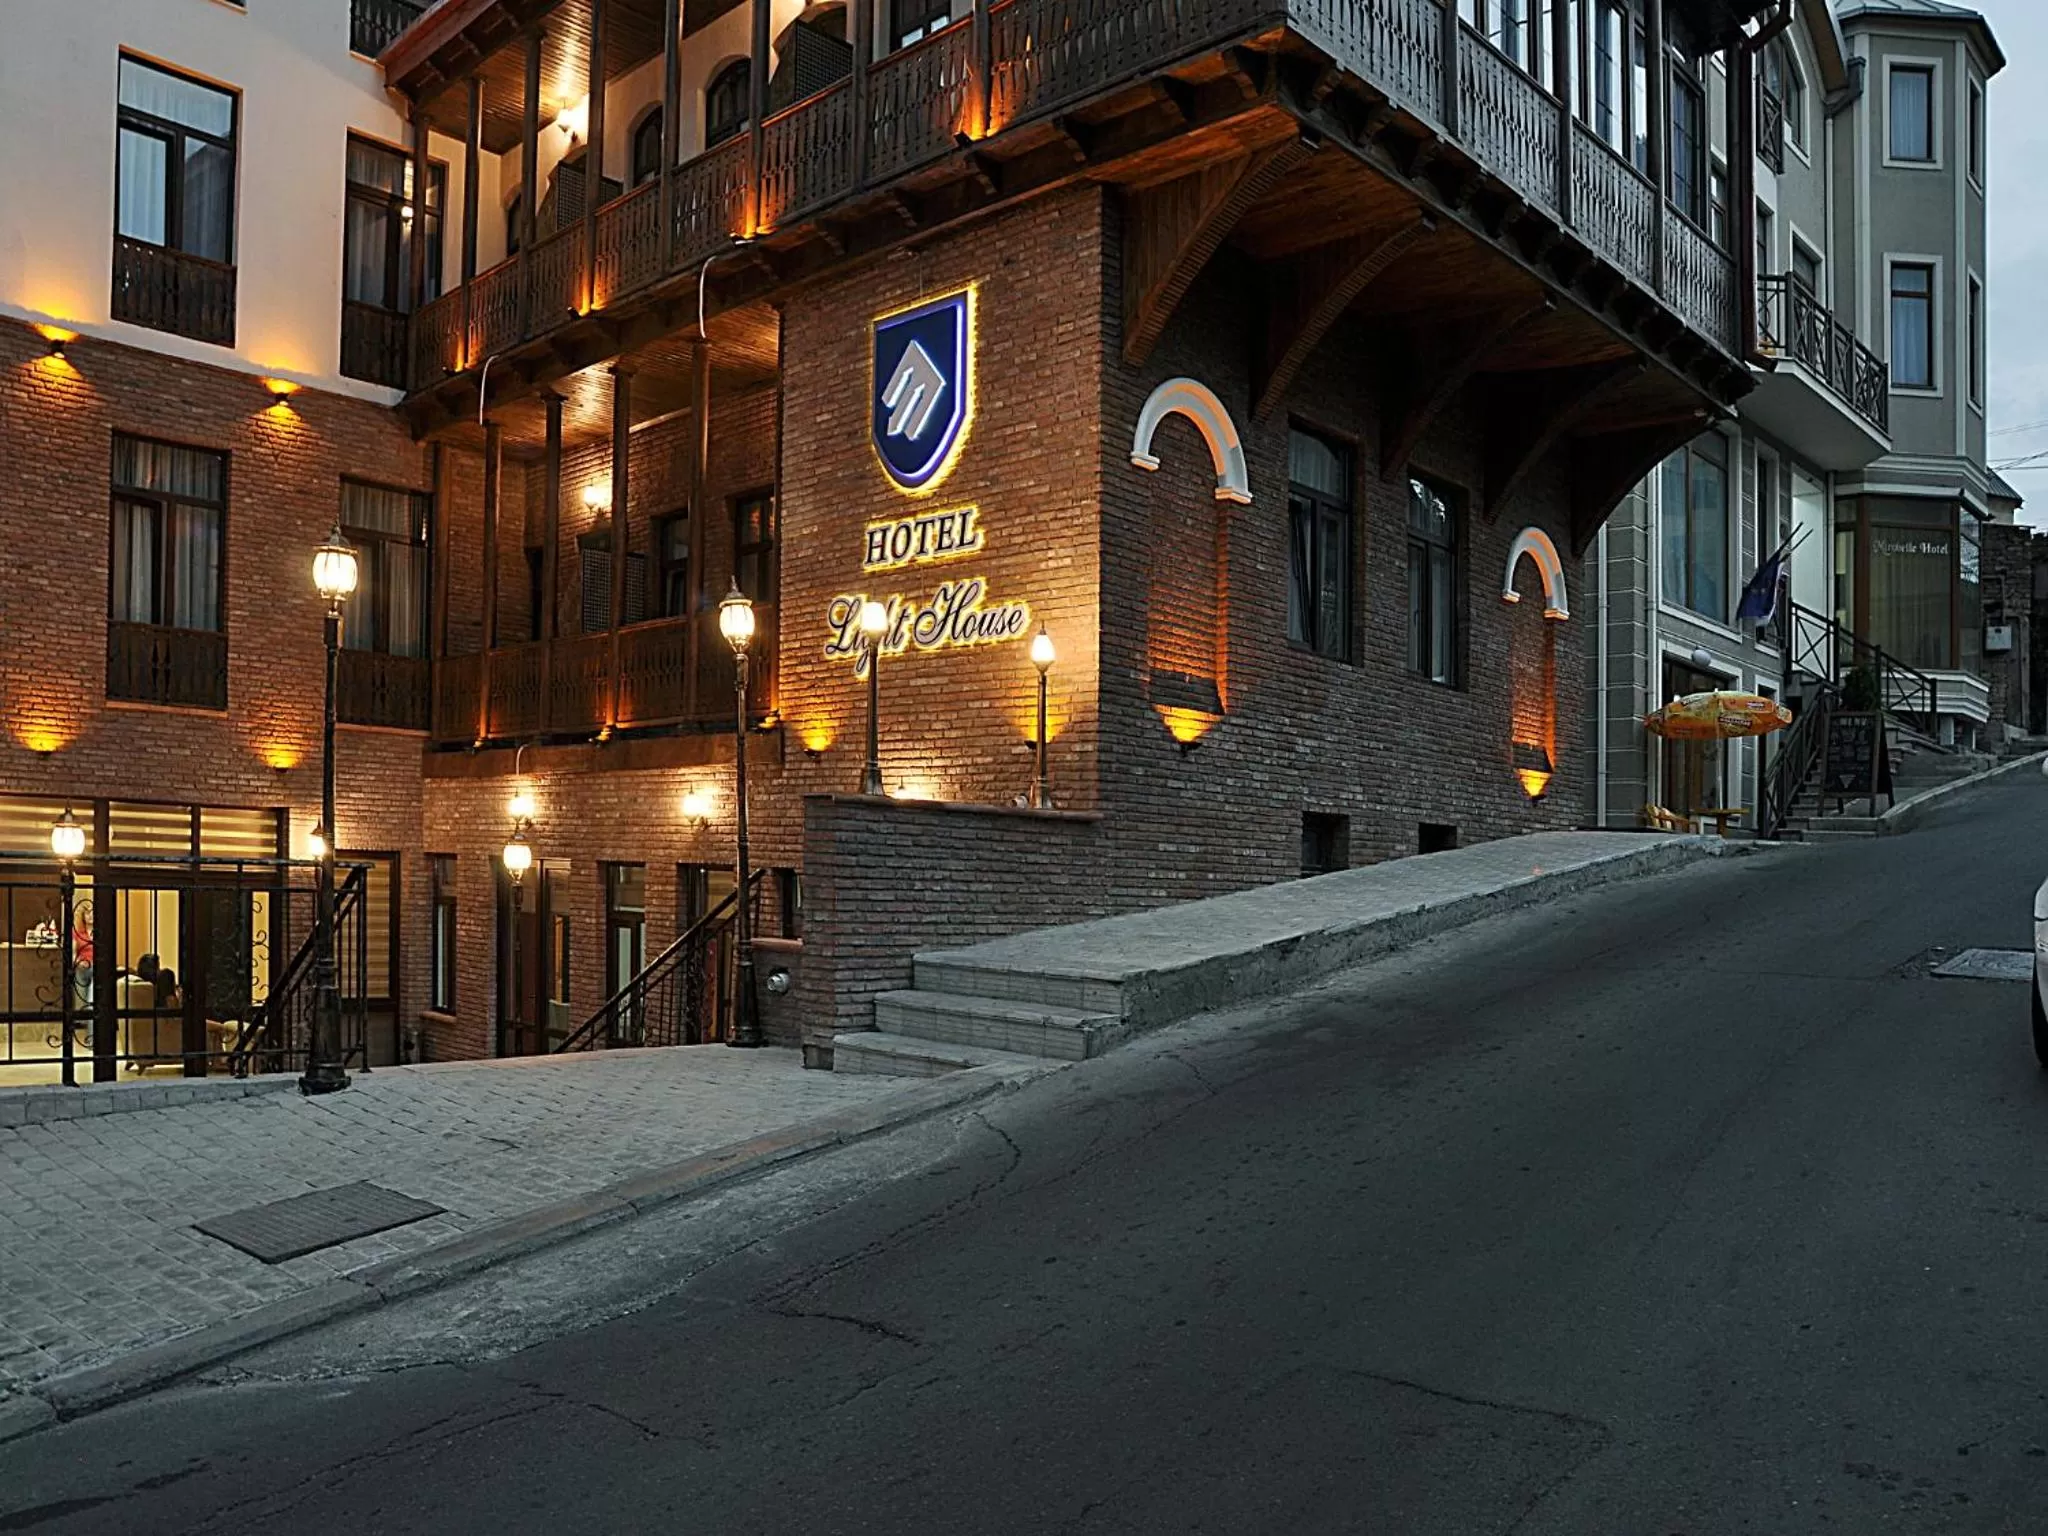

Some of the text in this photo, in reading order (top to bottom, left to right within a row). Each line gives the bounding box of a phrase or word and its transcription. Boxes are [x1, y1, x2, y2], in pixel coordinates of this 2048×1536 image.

[864, 509, 980, 566] HOTEL
[1920, 541, 1948, 555] Hotel
[914, 581, 1025, 646] House
